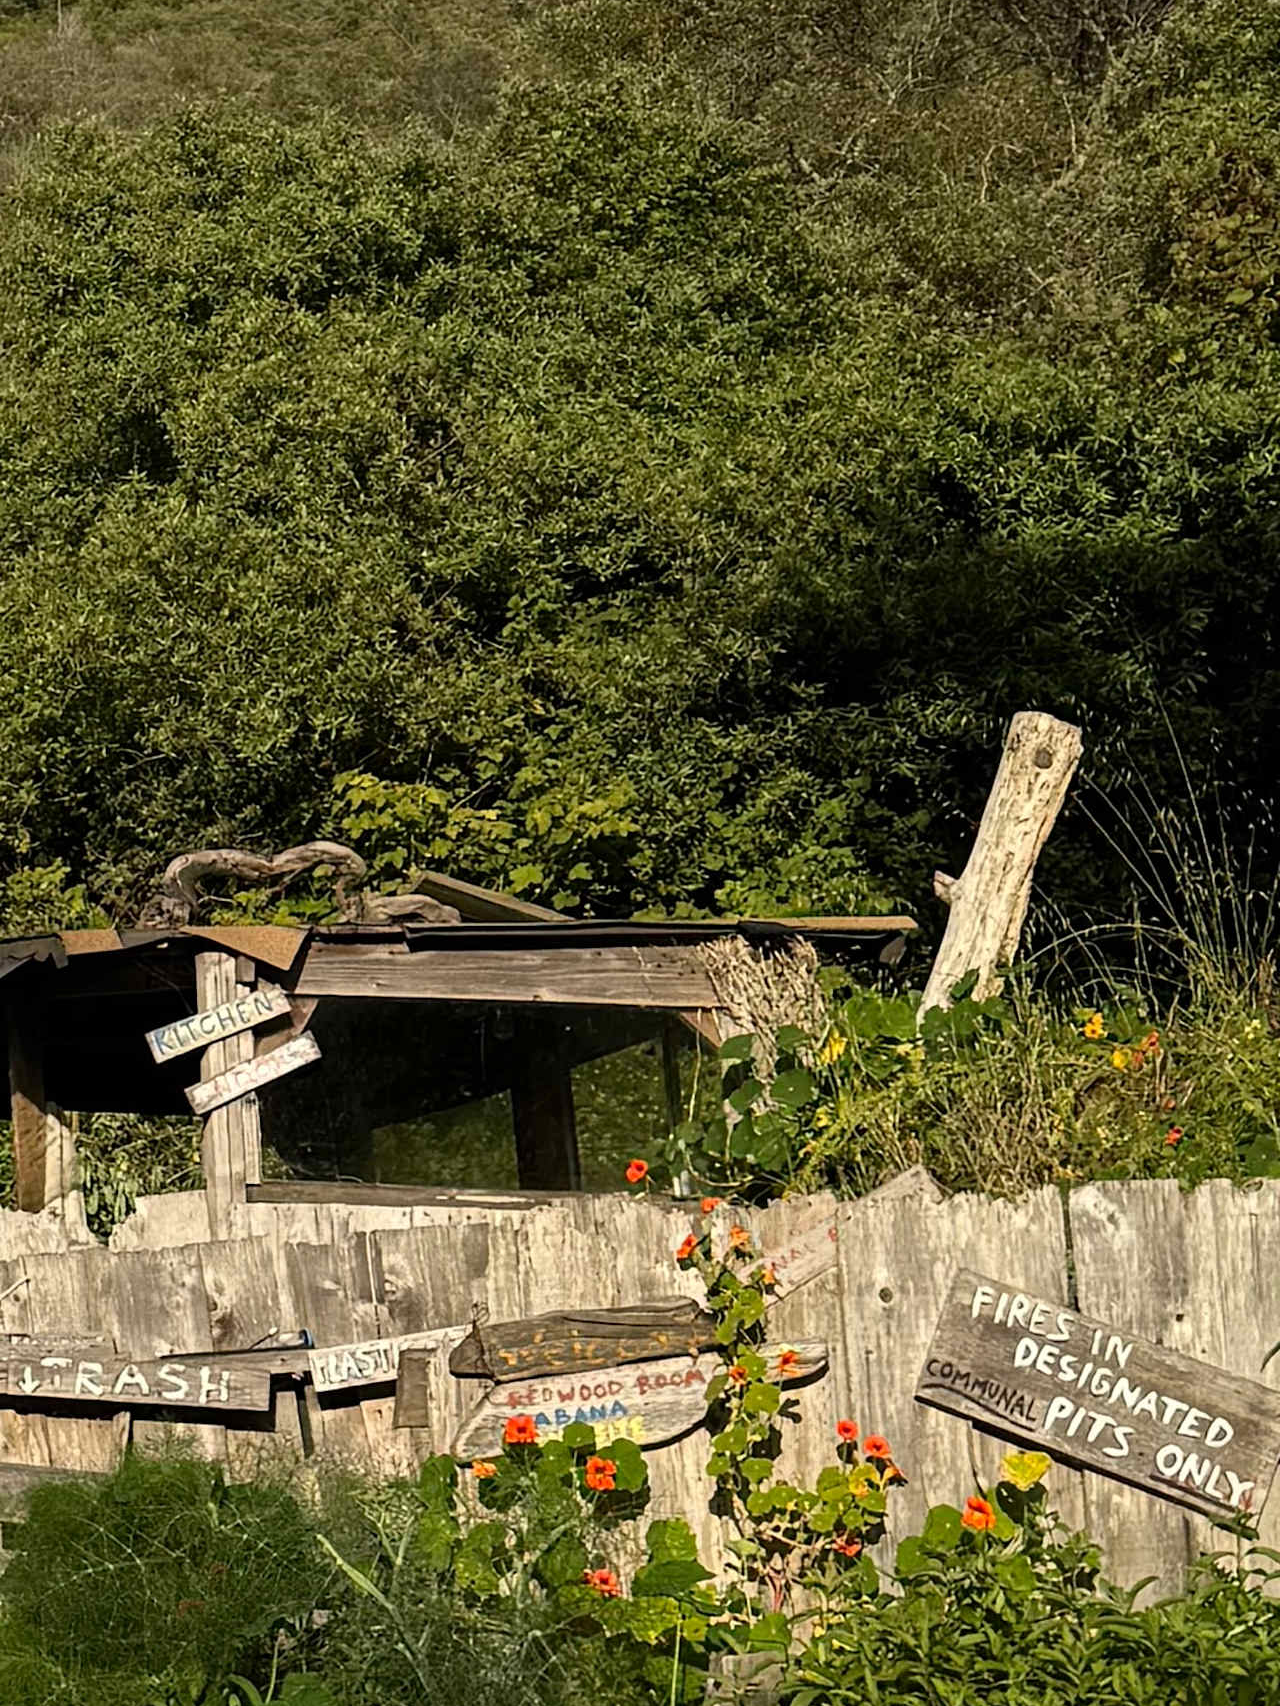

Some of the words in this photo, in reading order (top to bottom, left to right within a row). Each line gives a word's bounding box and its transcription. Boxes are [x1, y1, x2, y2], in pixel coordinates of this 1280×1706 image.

[155, 995, 273, 1055] KITCHEN
[971, 1286, 1076, 1342] FIRES
[1091, 1328, 1134, 1368] IN
[40, 1356, 231, 1404] TRASH
[506, 1380, 625, 1409] REDWOOD
[637, 1368, 708, 1397] ROOM
[1013, 1336, 1235, 1448] DESIGNATED
[535, 1399, 629, 1427] ABANA
[926, 1358, 1038, 1423] COMMUNAL
[1044, 1396, 1136, 1458] PITS
[1155, 1444, 1256, 1507] ONLY
